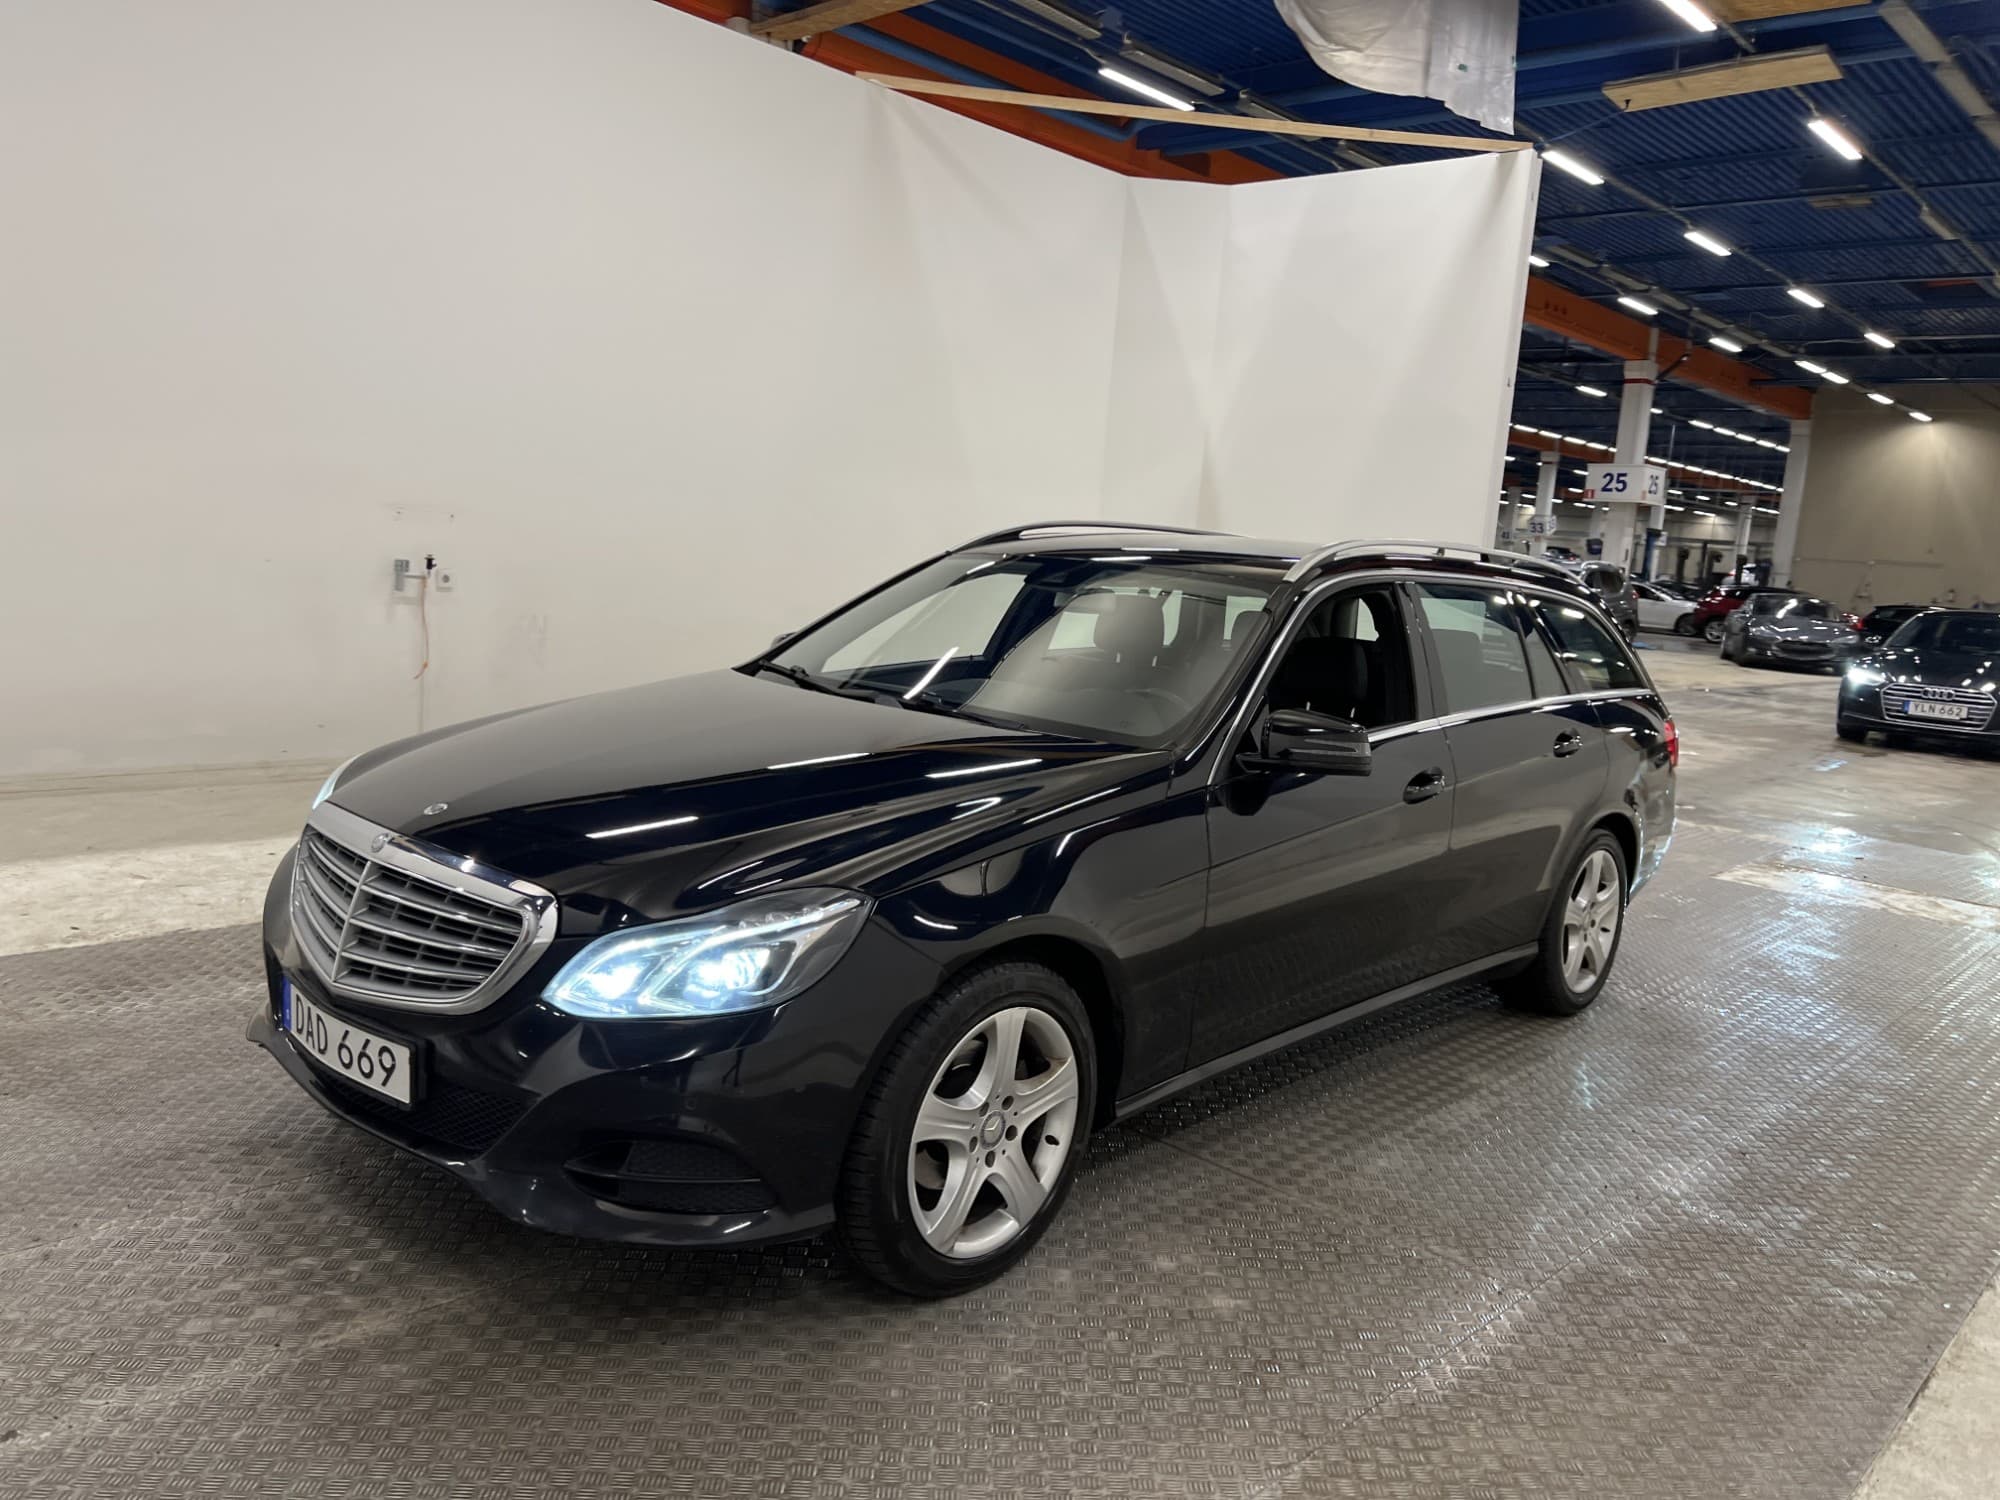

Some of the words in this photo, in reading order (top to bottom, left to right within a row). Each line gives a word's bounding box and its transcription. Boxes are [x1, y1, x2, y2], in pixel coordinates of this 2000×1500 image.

[1601, 472, 1628, 493] 25
[1648, 474, 1659, 495] 25
[1913, 702, 1936, 713] YLN
[1939, 706, 1962, 717] 662
[296, 993, 328, 1055] DAD
[338, 1029, 396, 1088] 669
